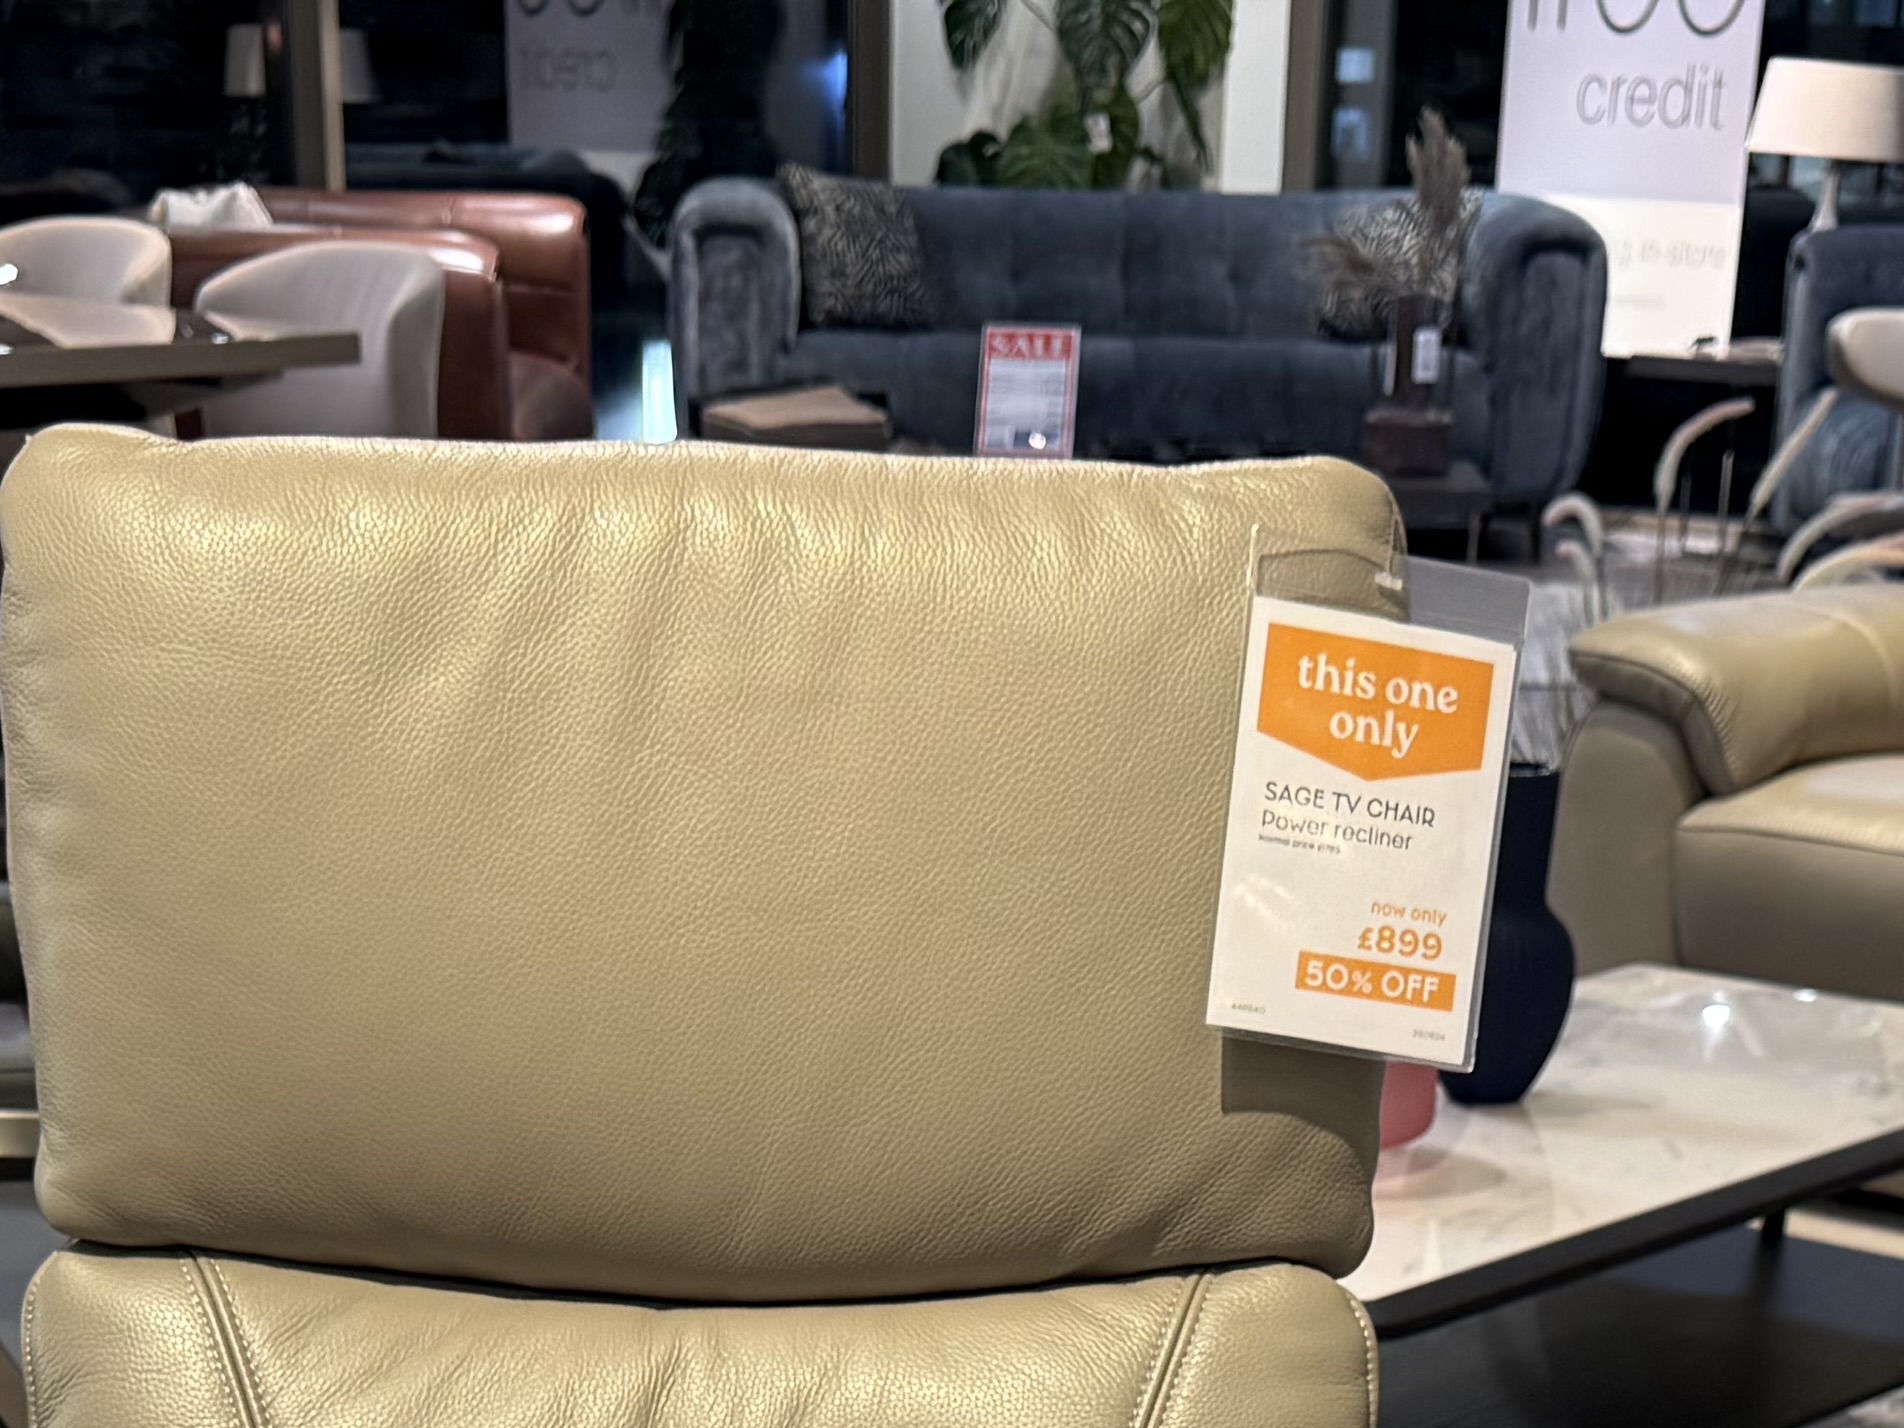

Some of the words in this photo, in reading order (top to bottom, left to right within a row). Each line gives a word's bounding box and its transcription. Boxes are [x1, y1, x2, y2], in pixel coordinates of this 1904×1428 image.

[1576, 63, 1726, 130] credit
[1298, 652, 1377, 700] this
[1385, 676, 1459, 714] one
[1329, 708, 1420, 759] only
[1264, 781, 1325, 809] SAGE
[1332, 791, 1362, 814] TV
[1366, 797, 1436, 828] CHAIR
[1261, 808, 1330, 837] Power
[1333, 825, 1414, 851] recliner
[1371, 901, 1407, 919] now
[1410, 905, 1448, 928] only
[1357, 925, 1443, 961] £899
[1304, 960, 1373, 994] 50%
[1380, 970, 1440, 1003] OFF
